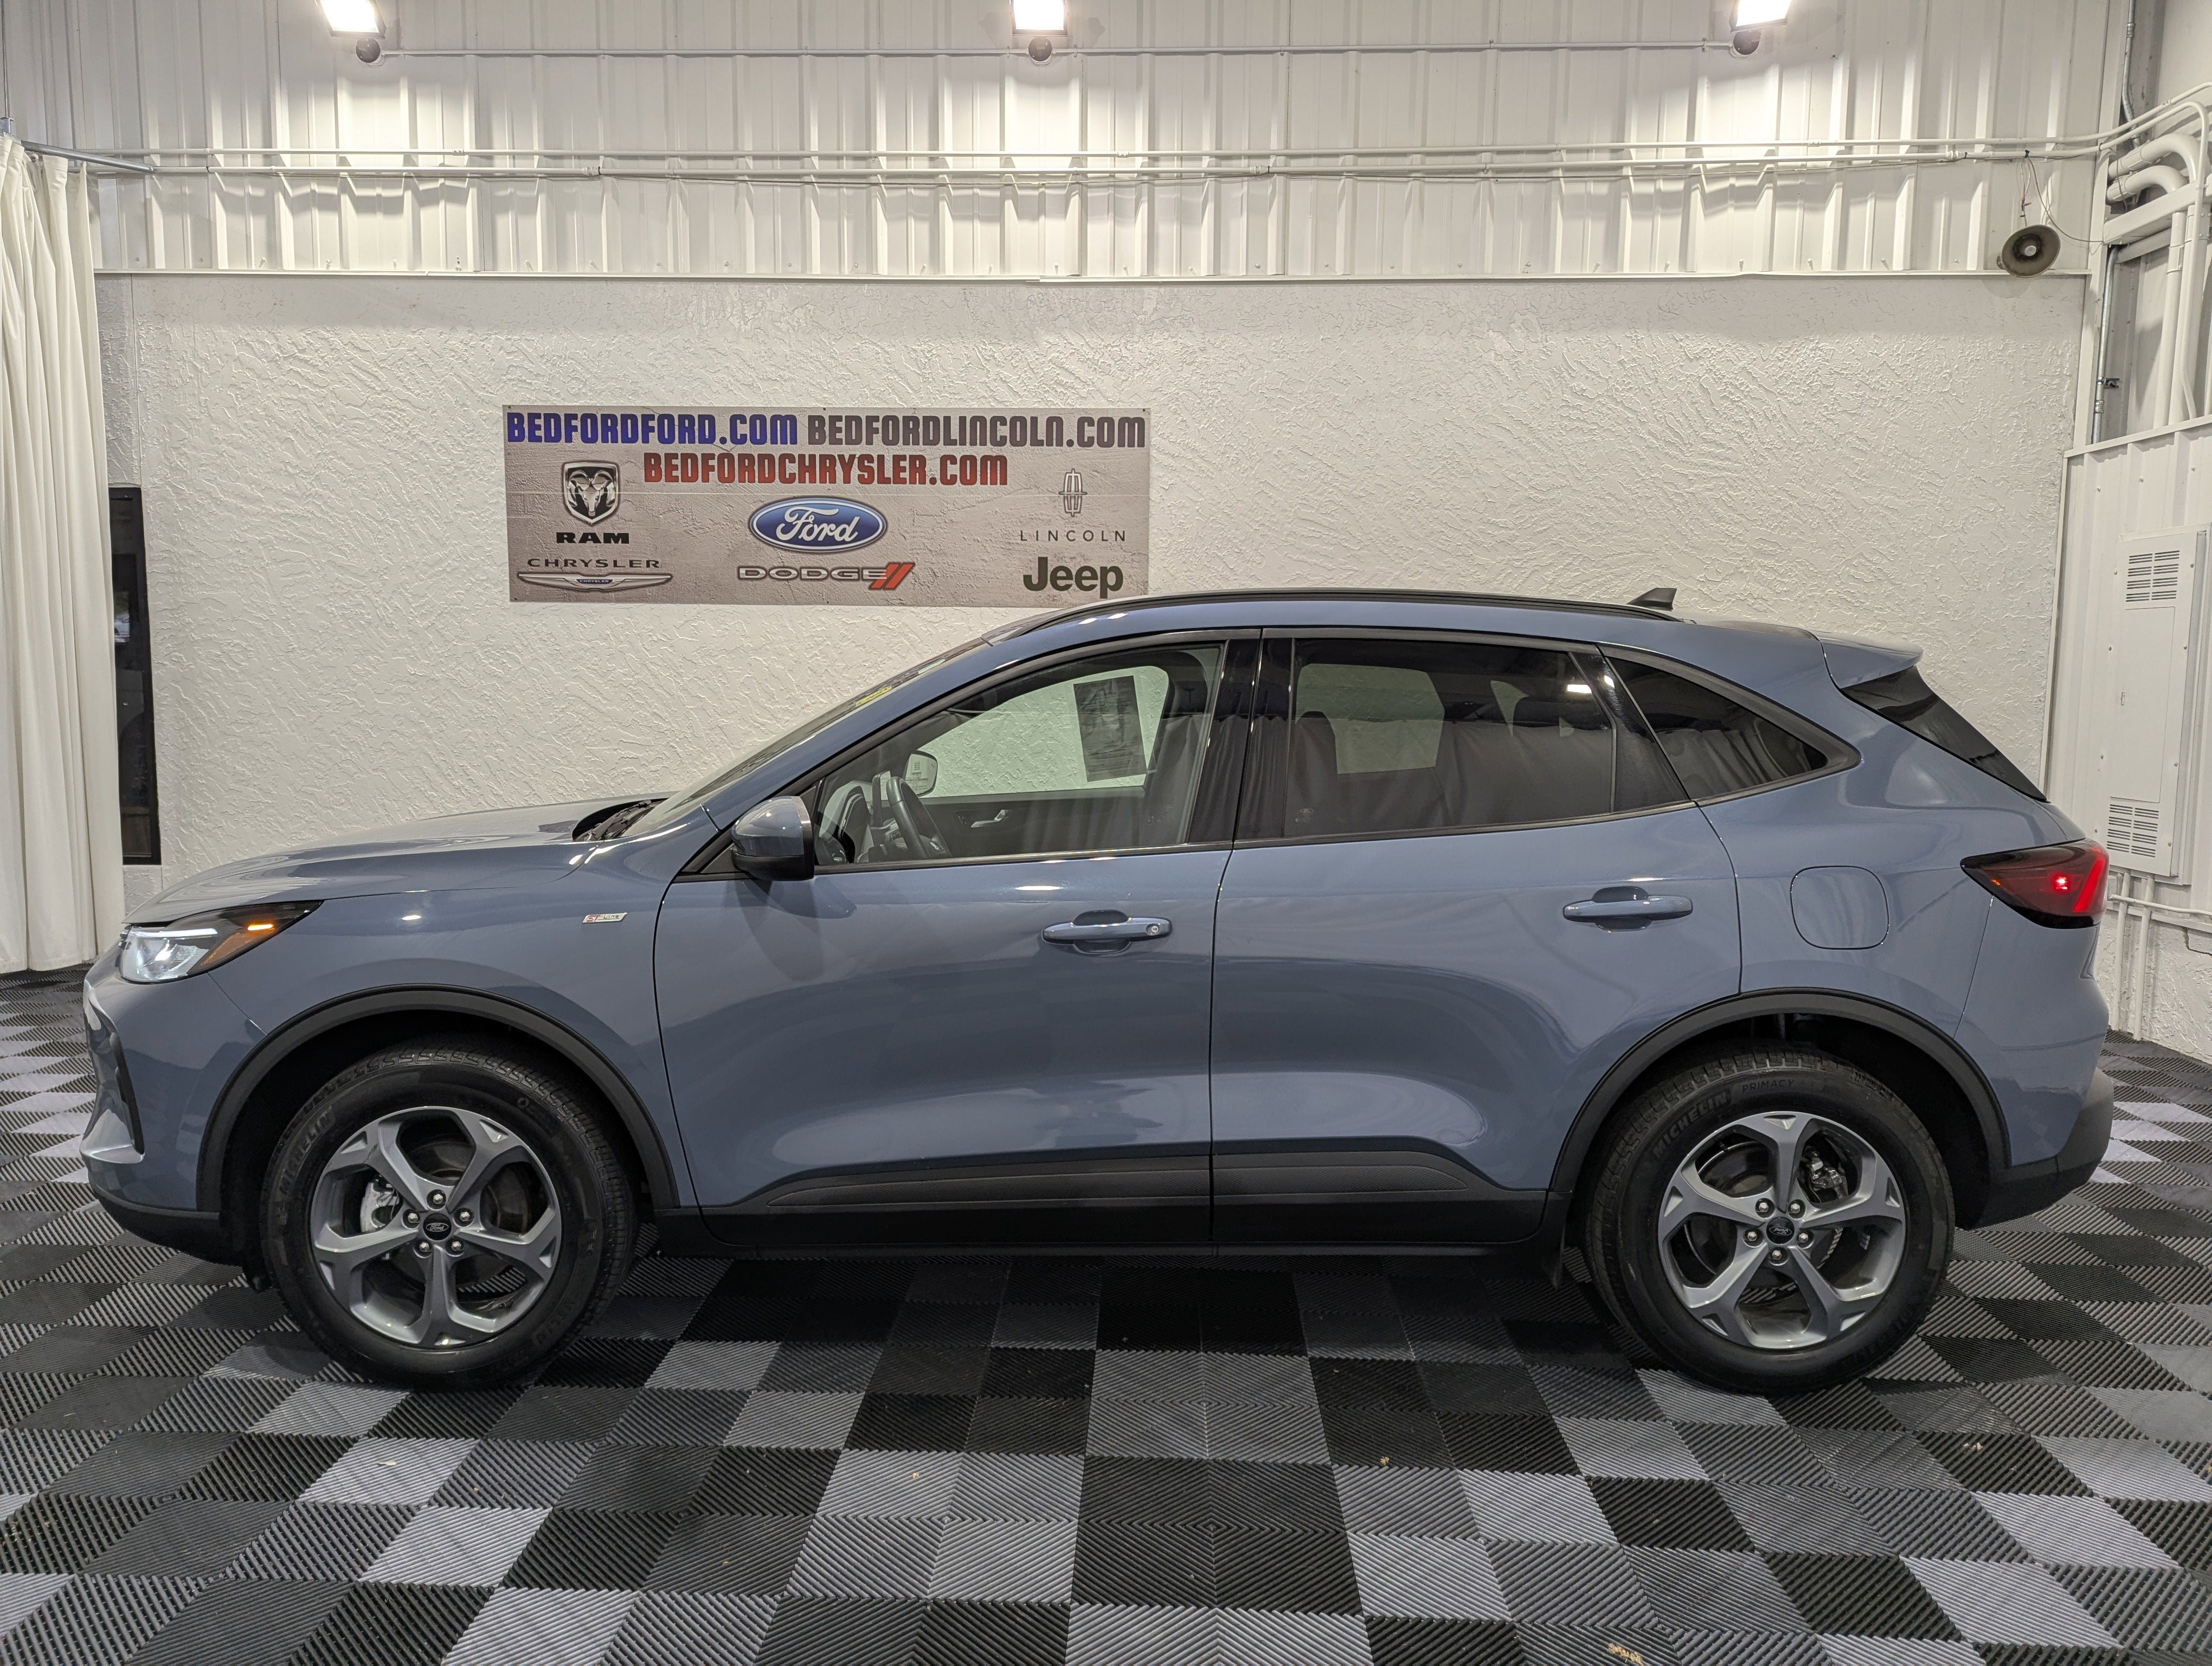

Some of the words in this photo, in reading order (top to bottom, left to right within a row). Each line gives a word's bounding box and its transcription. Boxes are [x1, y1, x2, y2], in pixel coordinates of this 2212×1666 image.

[507, 412, 798, 445] BEDFORDFORD.COM
[807, 415, 1145, 448] BEDFORDLINCOLN.COM
[644, 452, 1008, 486] BEDFORDCHRYSLER.COM
[556, 532, 629, 544] RAM
[776, 506, 860, 541] Ford
[1020, 530, 1126, 542] LINCOLN
[527, 558, 660, 568] CHRYSLER
[739, 568, 887, 580] DODGE
[1023, 556, 1124, 599] Jeep
[1742, 1079, 1795, 1094] PRIMACY
[1654, 1091, 1728, 1159] MICHELIN
[279, 1110, 333, 1194] MICHELIN
